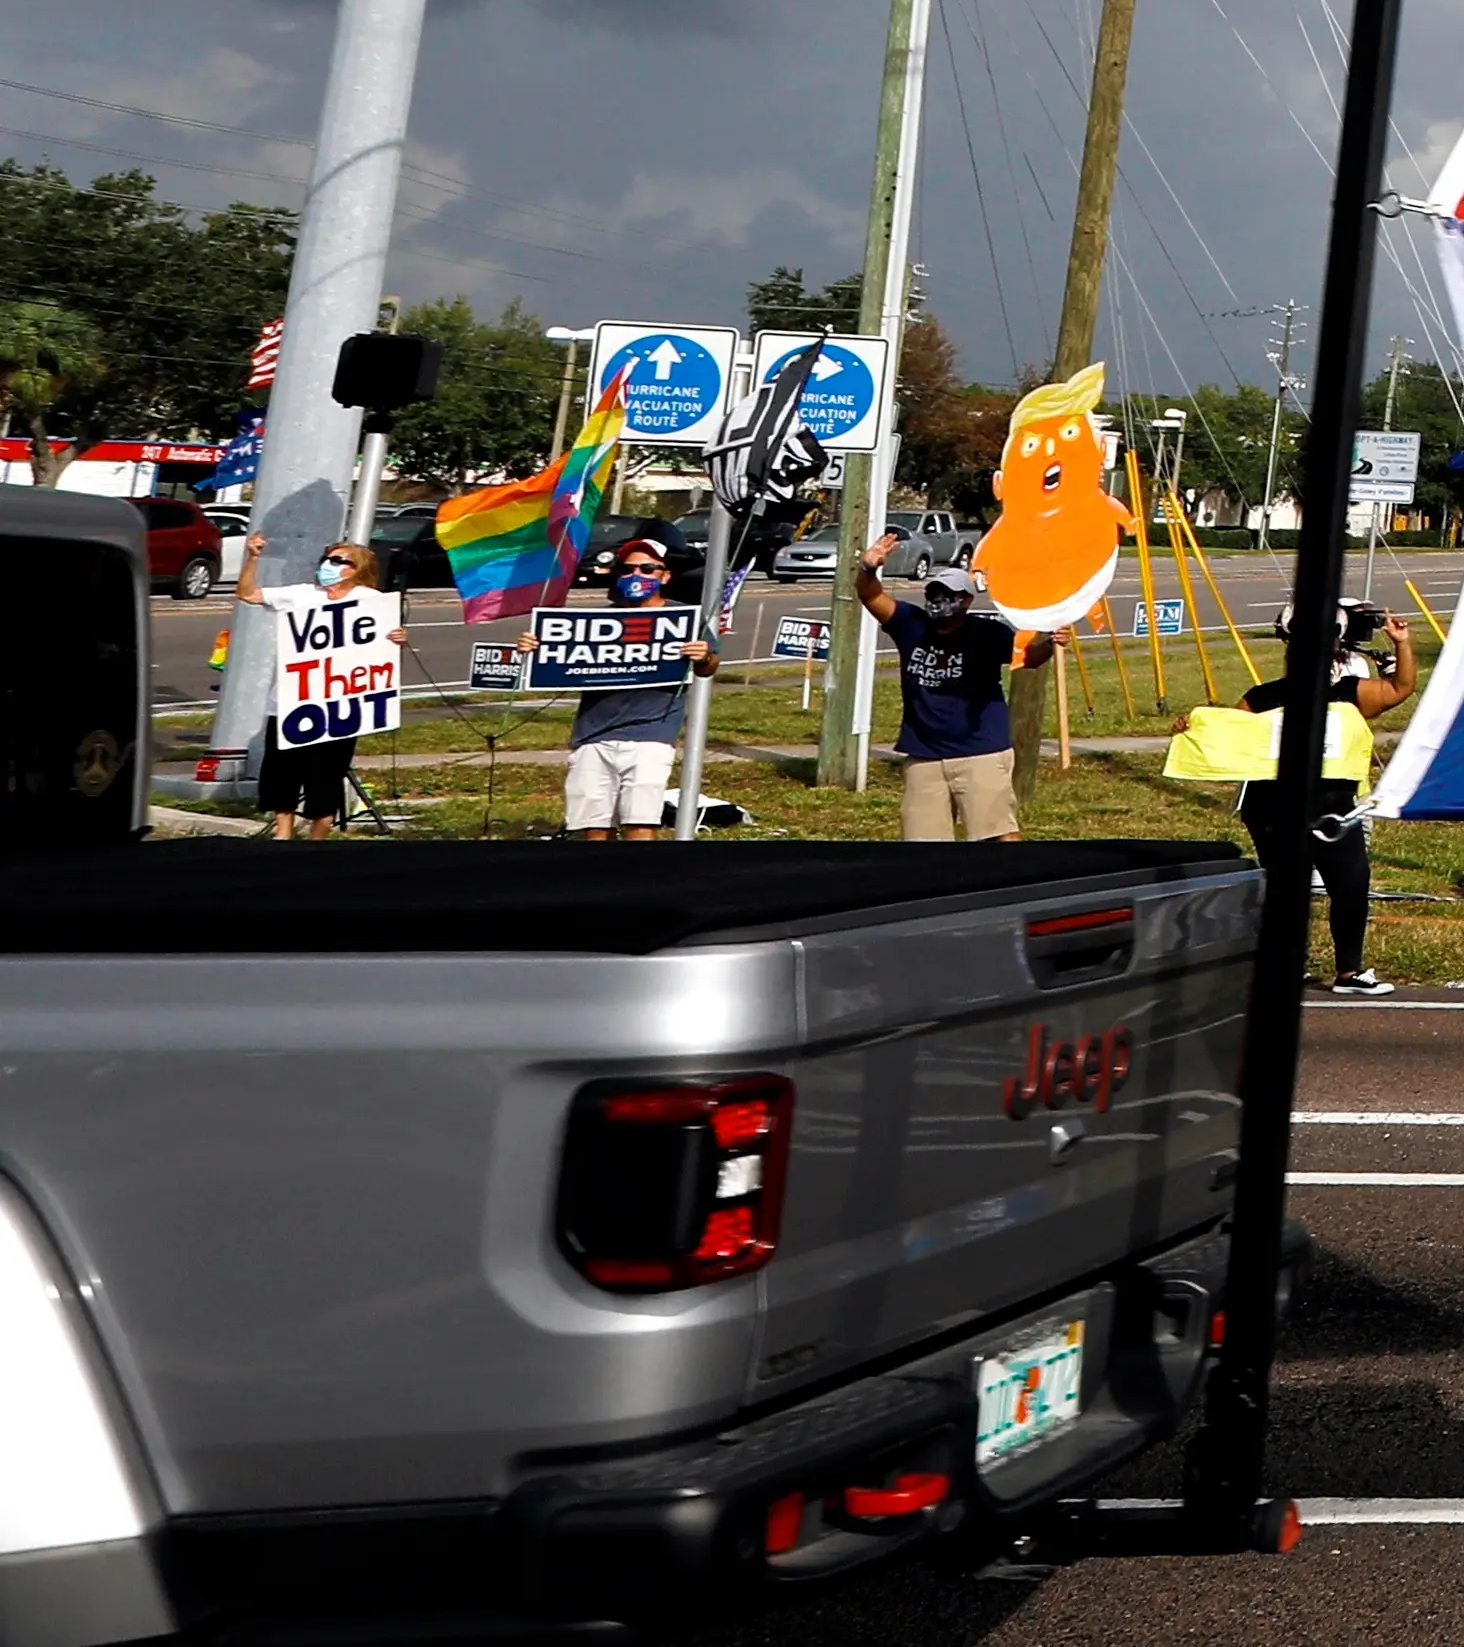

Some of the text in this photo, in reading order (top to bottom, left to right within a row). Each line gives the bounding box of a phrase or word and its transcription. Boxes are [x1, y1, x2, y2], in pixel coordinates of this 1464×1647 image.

[633, 415, 679, 429] ROUTE
[540, 615, 689, 643] BIDEN
[474, 647, 523, 664] BIDEN
[538, 640, 684, 665] HARRIS
[473, 663, 521, 677] HARRIS
[564, 664, 658, 676] JOEBIDEN.COM
[281, 689, 398, 745] OUT
[1003, 1023, 1133, 1121] Jeep
